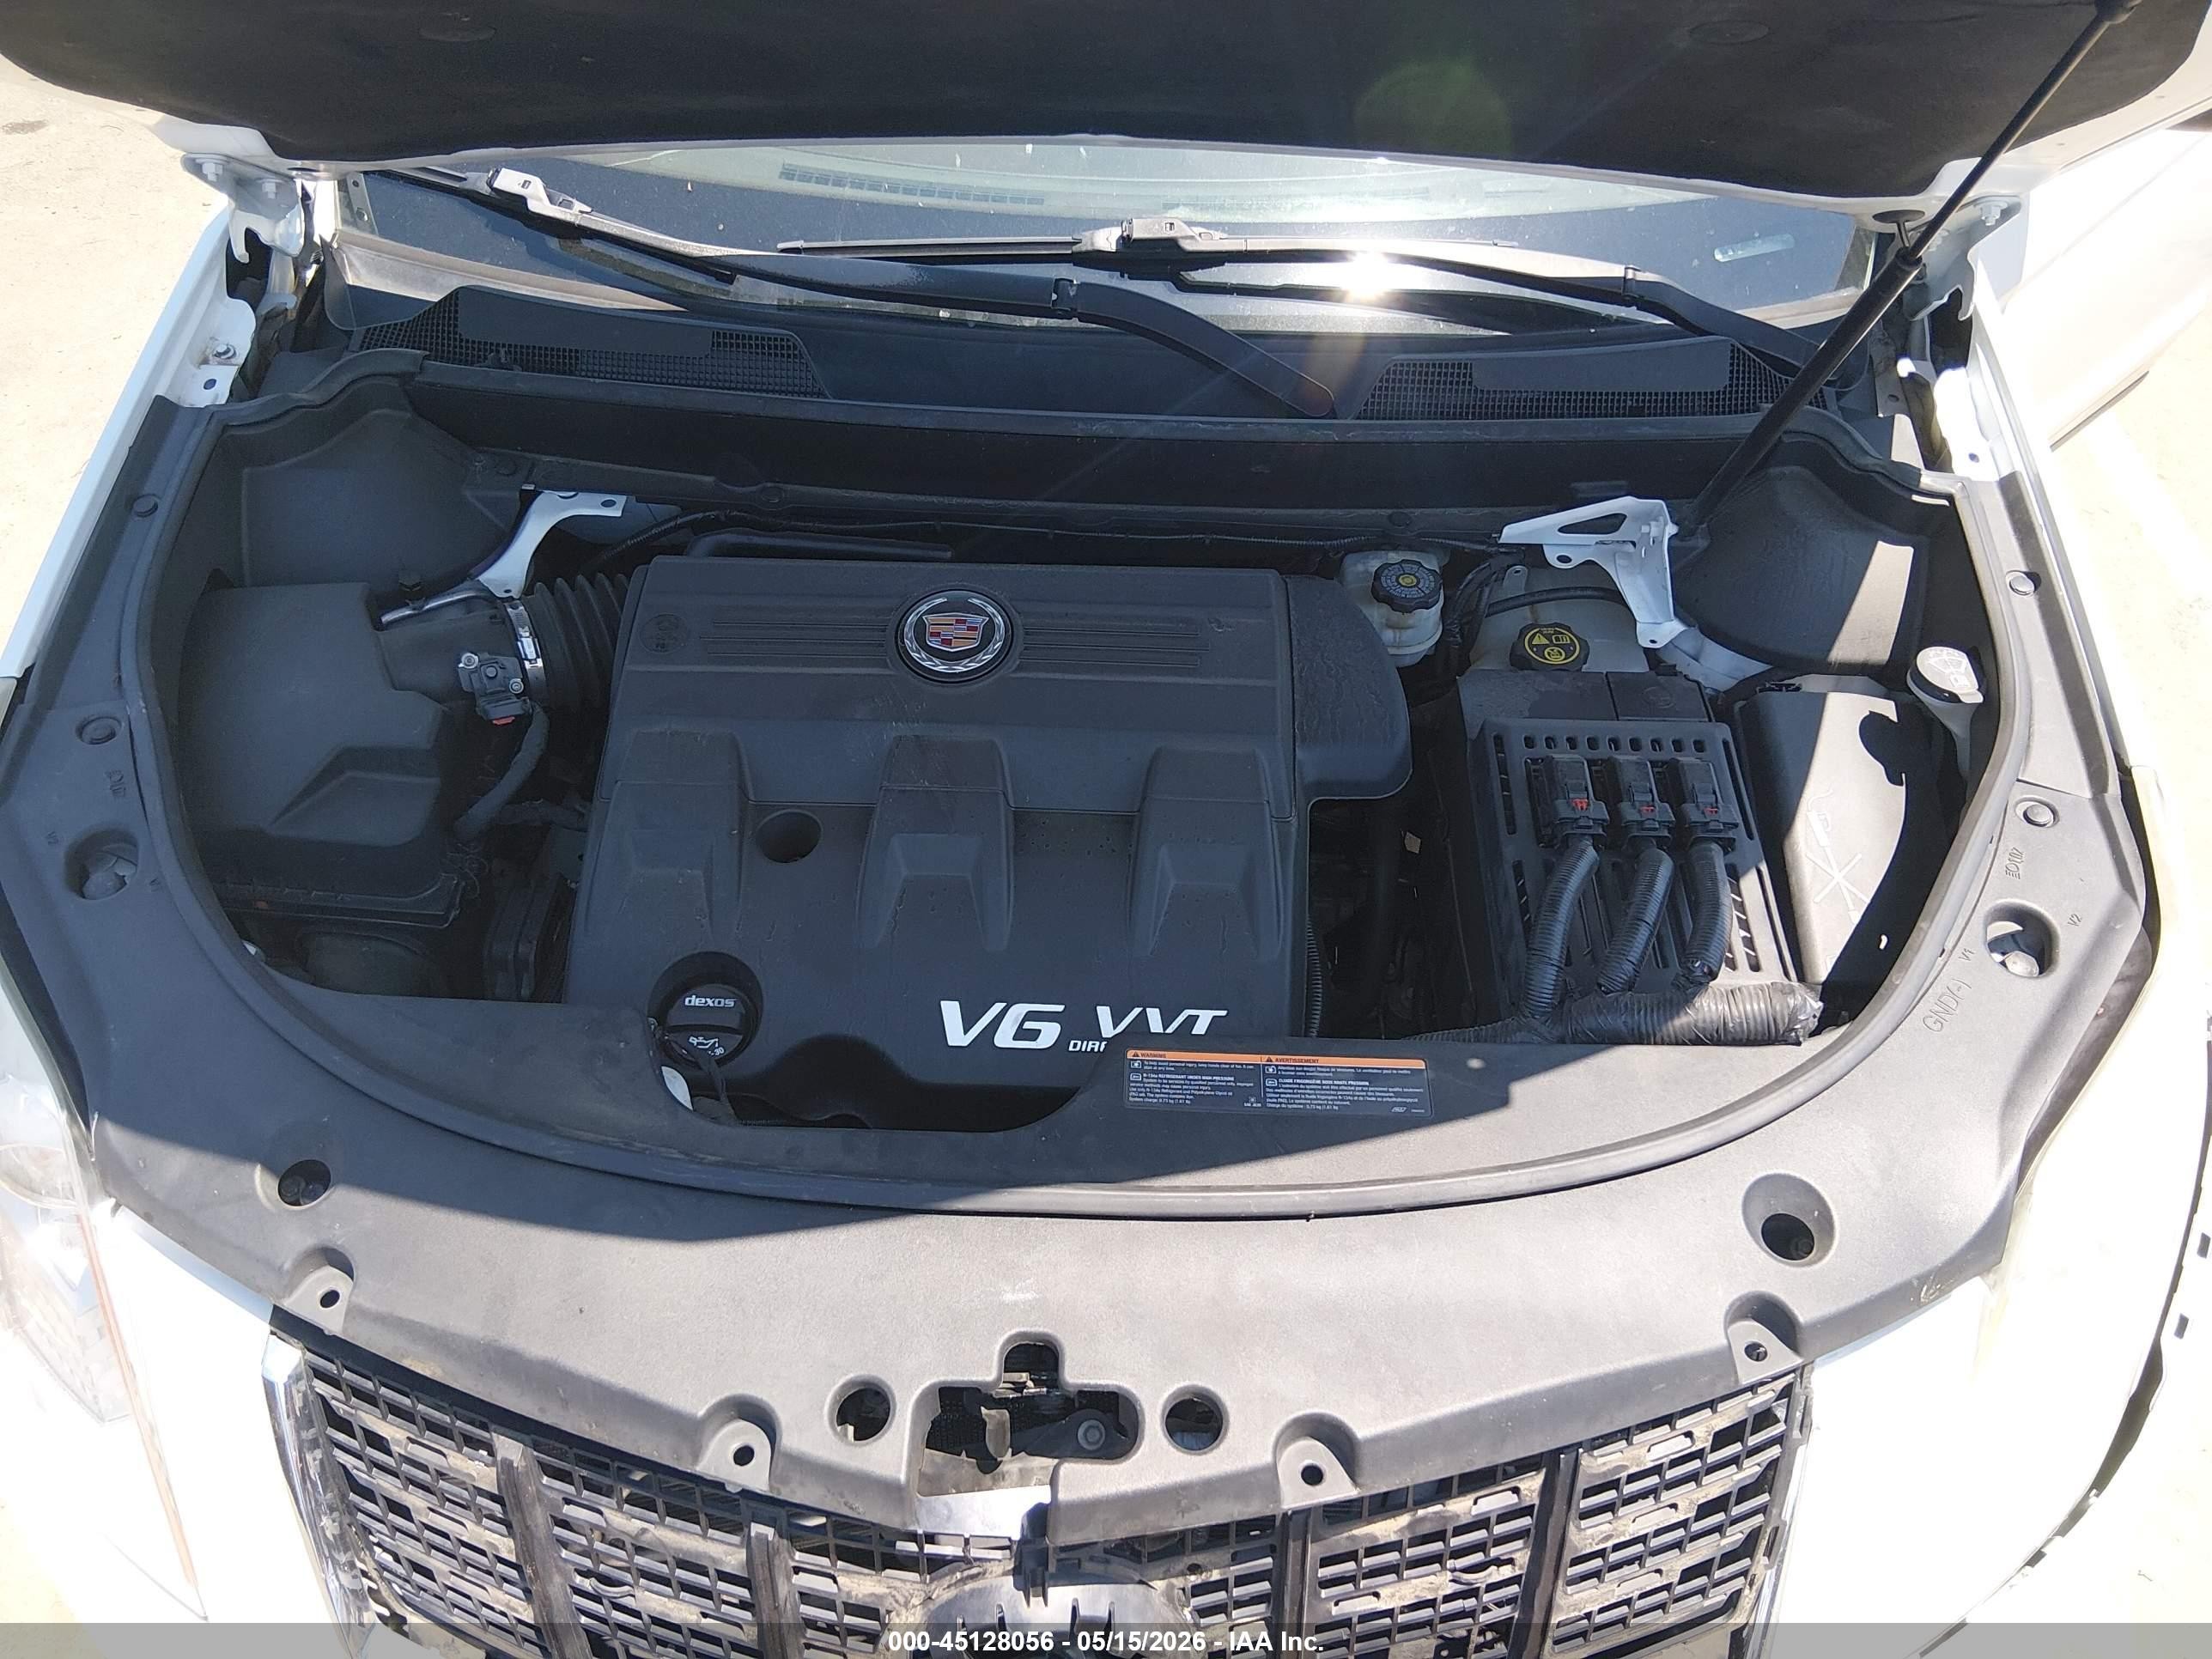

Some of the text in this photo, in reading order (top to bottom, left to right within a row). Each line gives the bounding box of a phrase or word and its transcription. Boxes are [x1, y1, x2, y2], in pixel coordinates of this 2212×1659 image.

[684, 994, 738, 1008] dexos
[939, 1000, 1228, 1049] V6 VVT
